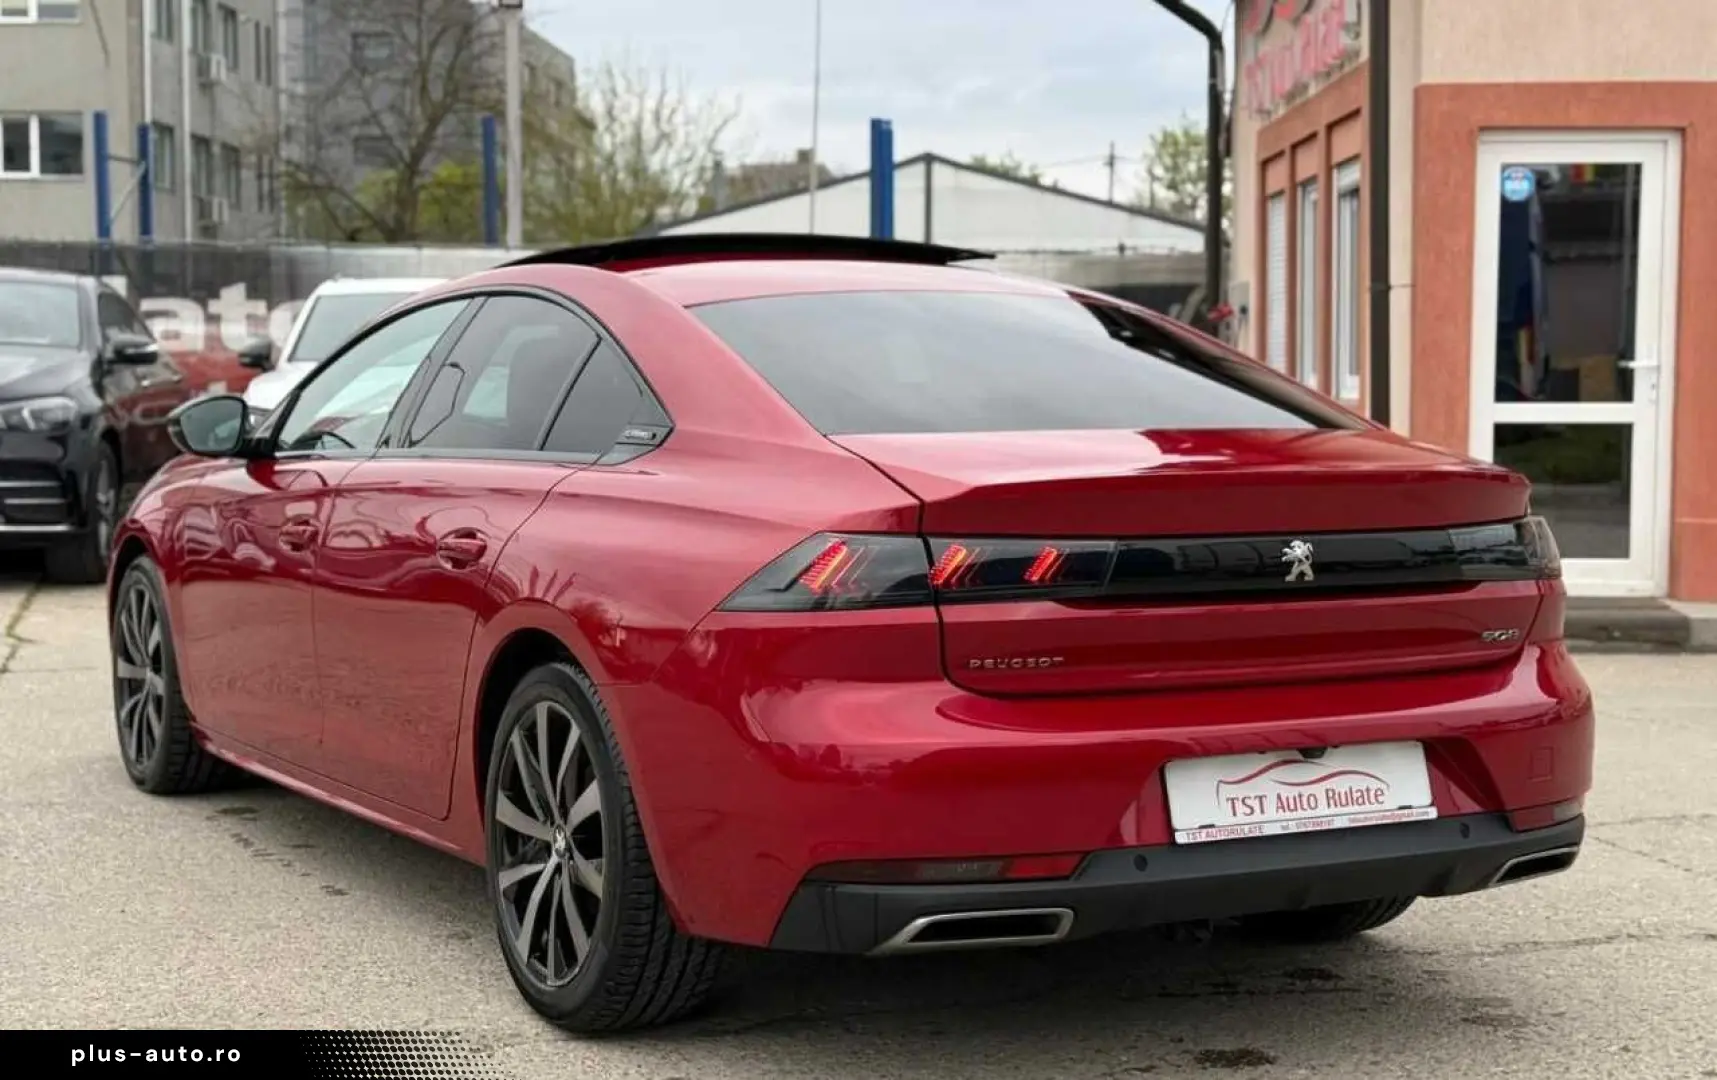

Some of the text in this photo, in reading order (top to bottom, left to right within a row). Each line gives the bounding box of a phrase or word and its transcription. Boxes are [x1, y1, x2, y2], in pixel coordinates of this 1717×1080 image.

[1226, 785, 1385, 818] TST Auto Rulate
